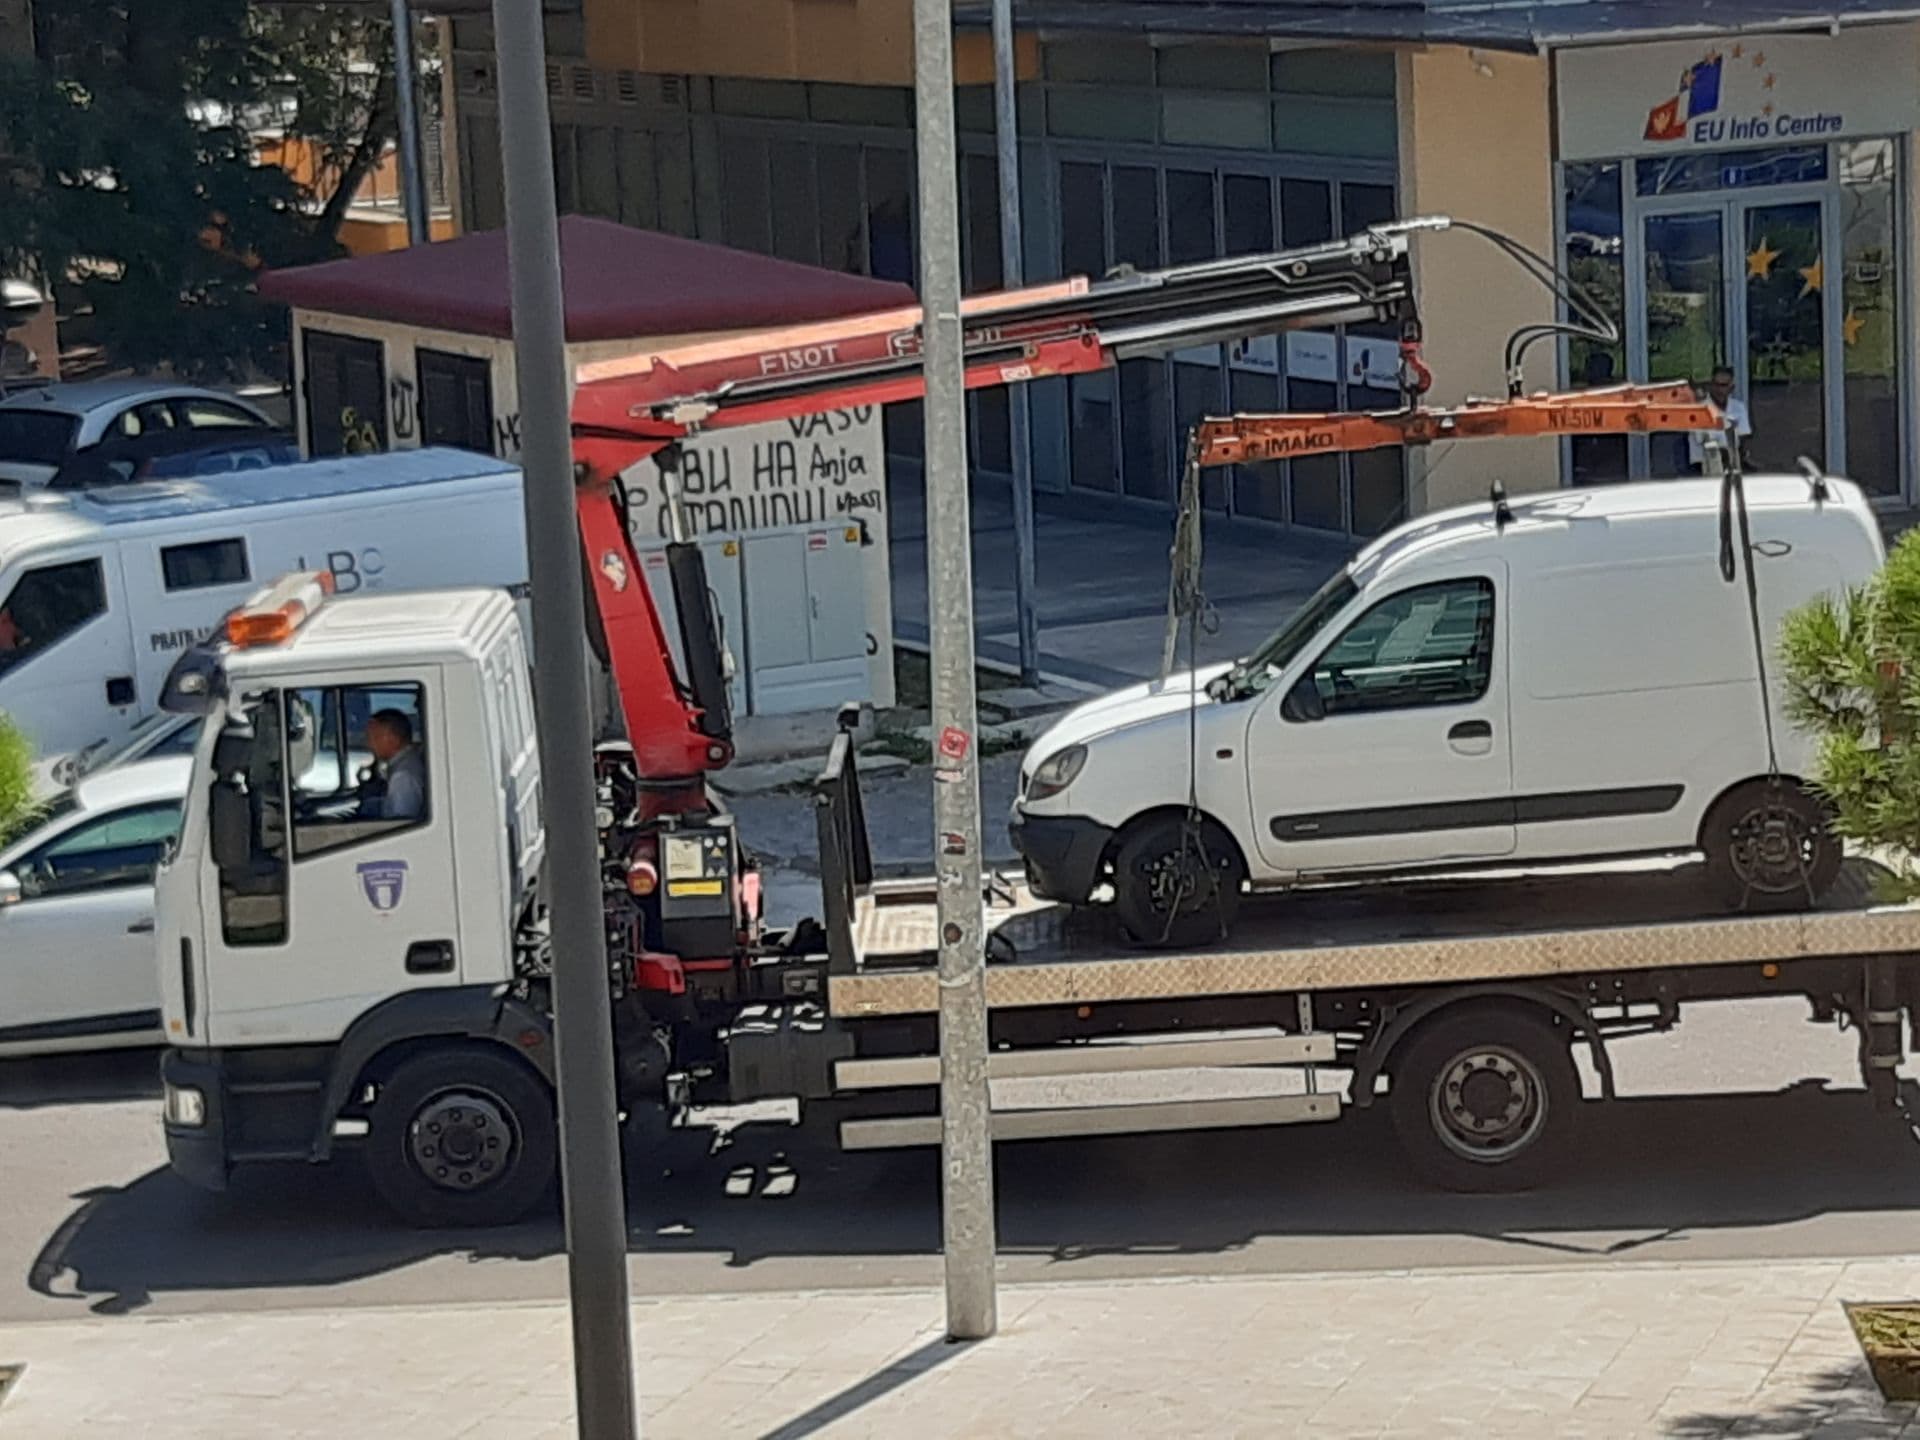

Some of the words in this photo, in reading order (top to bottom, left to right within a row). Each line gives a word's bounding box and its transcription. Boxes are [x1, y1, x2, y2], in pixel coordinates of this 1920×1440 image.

[1694, 120, 1725, 143] EU
[1729, 116, 1769, 140] Info
[1775, 112, 1843, 136] Centre
[1265, 432, 1334, 457] IMAKO
[808, 443, 867, 486] Anja
